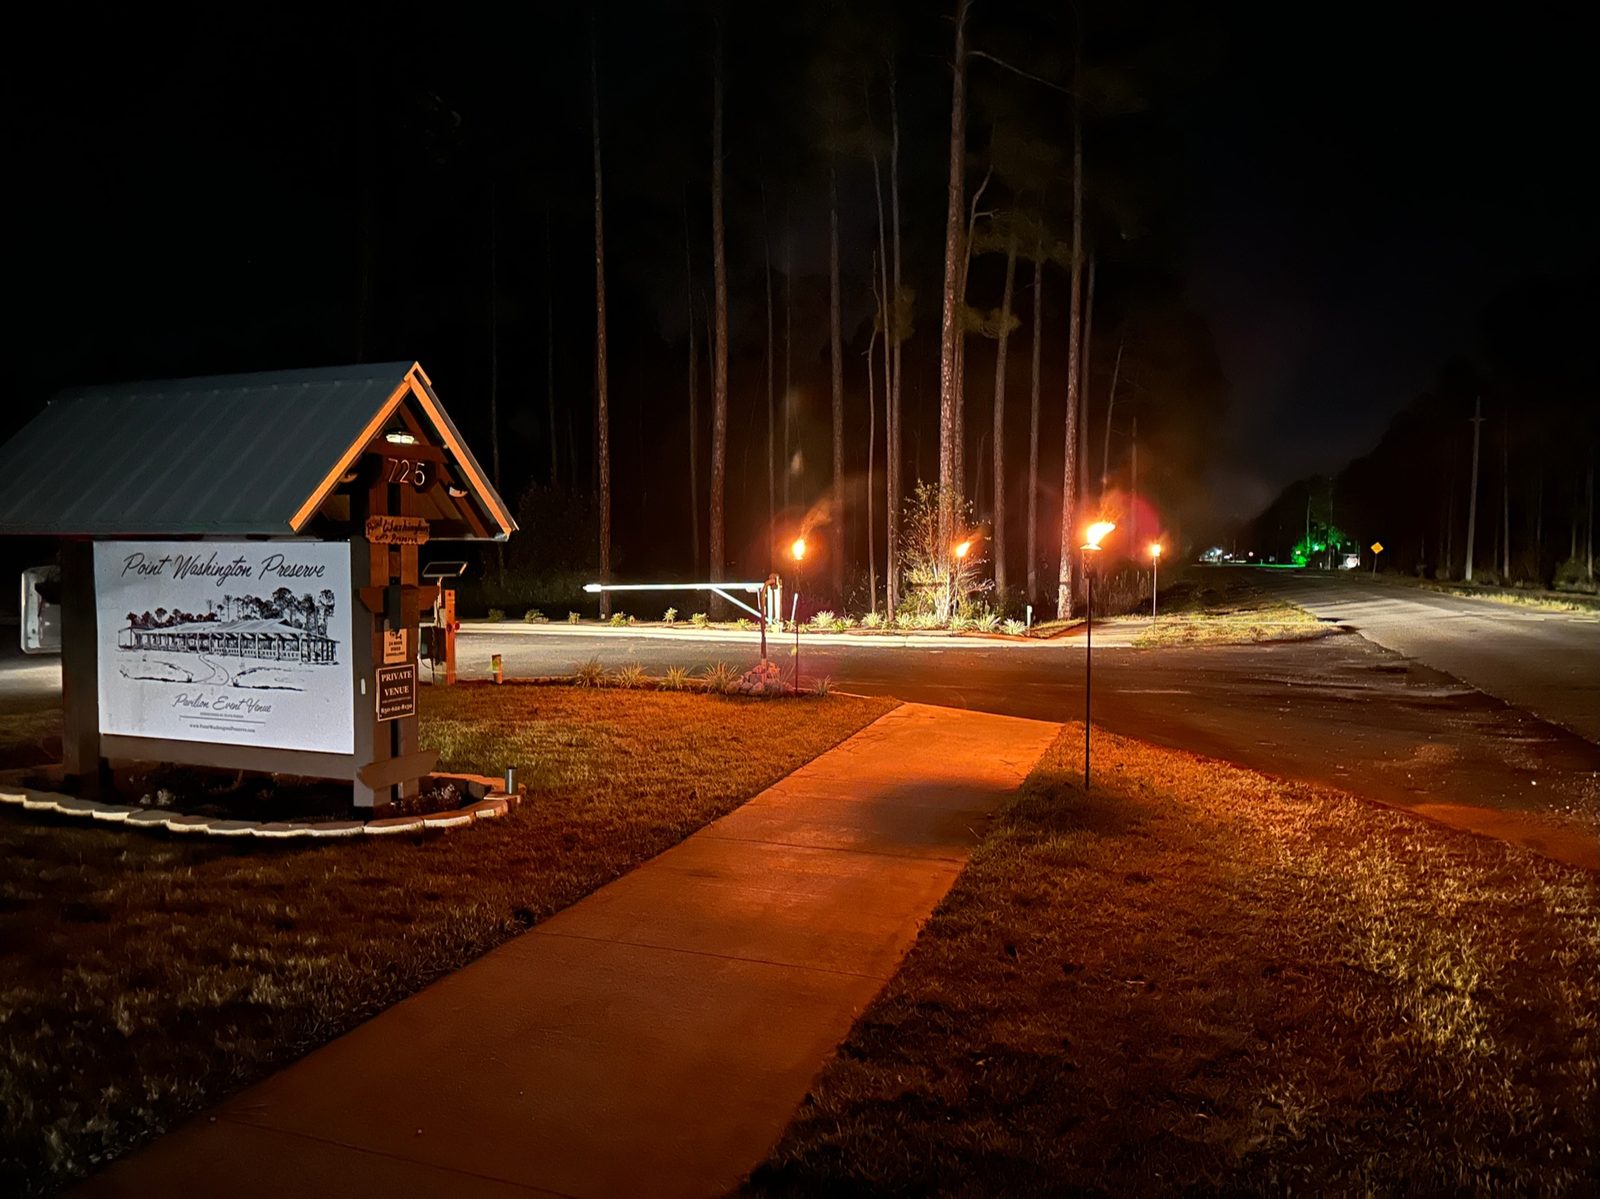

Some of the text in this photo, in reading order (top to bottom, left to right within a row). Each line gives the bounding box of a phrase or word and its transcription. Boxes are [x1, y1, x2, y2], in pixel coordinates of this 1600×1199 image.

[388, 458, 425, 486] 725
[121, 552, 326, 587] Point Washington Preserve
[381, 670, 412, 682] PRIVATE
[384, 685, 410, 697] VENUE
[212, 696, 246, 710] Event
[245, 697, 272, 713] Venue
